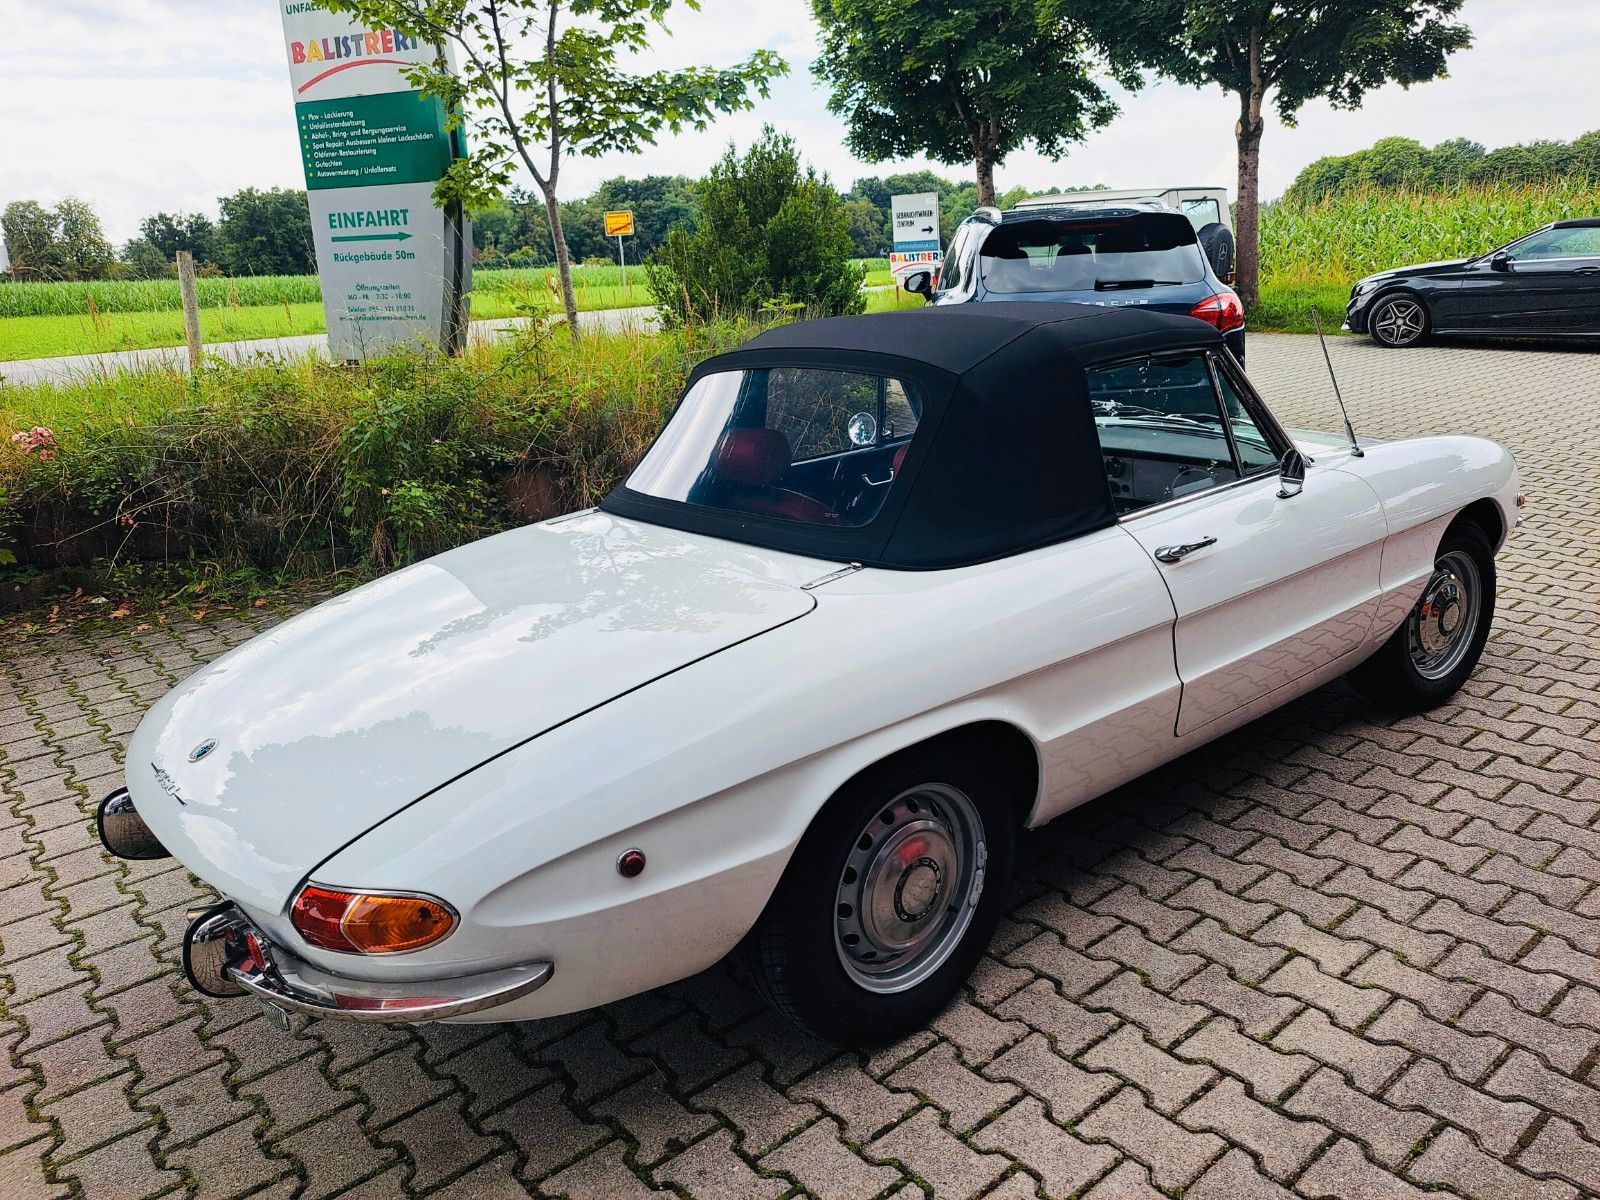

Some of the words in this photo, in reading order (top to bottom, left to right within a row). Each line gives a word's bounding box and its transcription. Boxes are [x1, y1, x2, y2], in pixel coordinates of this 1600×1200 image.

[291, 29, 418, 64] BALISTRERI
[324, 111, 354, 120] Lackierung
[309, 119, 366, 130] Unfallinstandsetzung
[350, 128, 361, 136] und
[361, 125, 407, 136] Bergungsservice
[312, 142, 325, 150] Spot
[325, 140, 345, 149] Repair:
[345, 138, 377, 147] Ausbessern
[377, 135, 398, 143] kleiner
[397, 132, 434, 142] Lackschäden
[313, 148, 377, 159] Oldtimer-Restaurierung
[315, 160, 343, 168] Gutachten
[317, 168, 360, 178] Autovermietung
[364, 165, 398, 174] Unfallersatz
[328, 208, 409, 229] EINFAHRT
[333, 250, 393, 263] Rückgebäude
[395, 250, 416, 260] 50m
